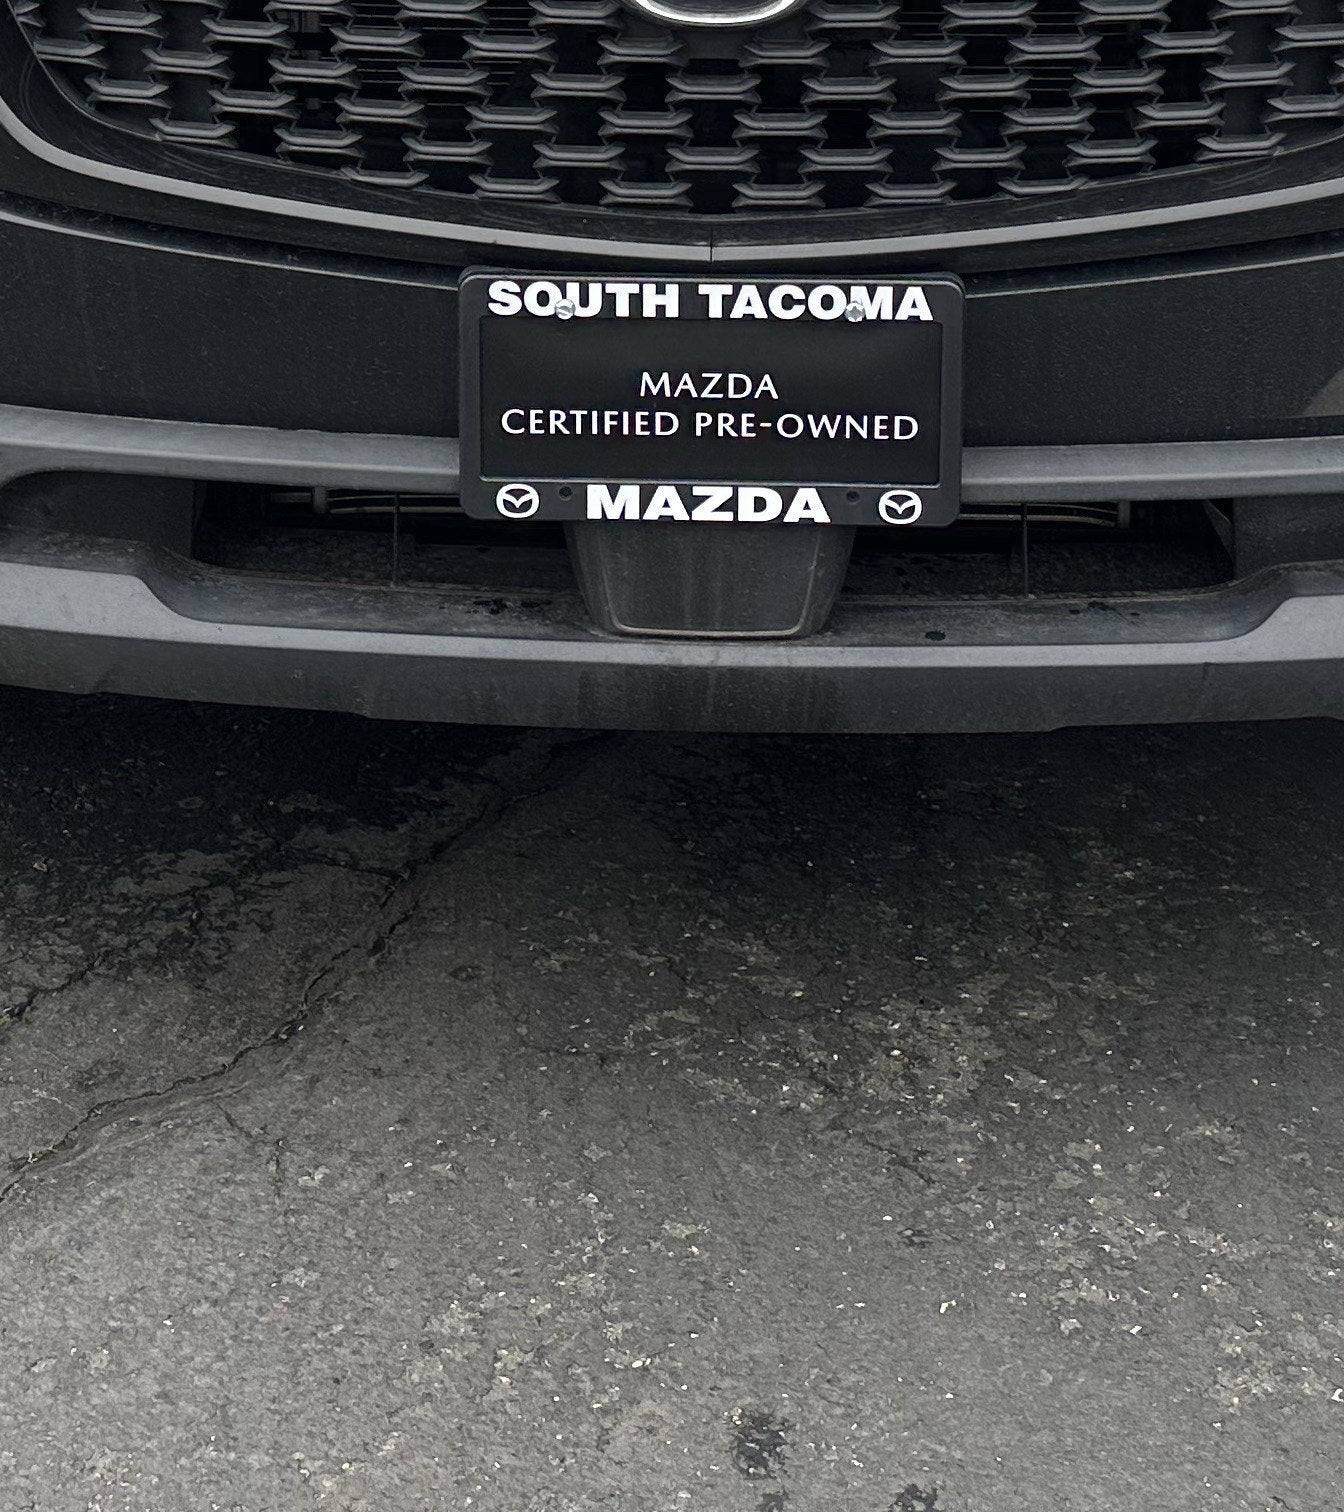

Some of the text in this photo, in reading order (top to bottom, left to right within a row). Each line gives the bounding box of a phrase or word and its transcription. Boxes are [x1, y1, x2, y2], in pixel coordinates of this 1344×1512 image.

[488, 280, 934, 321] SOUTH TACOMA
[639, 371, 779, 400] MAZDA
[501, 408, 919, 441] CERTIFIED PRE-OWNED
[586, 484, 831, 524] MAZDA
